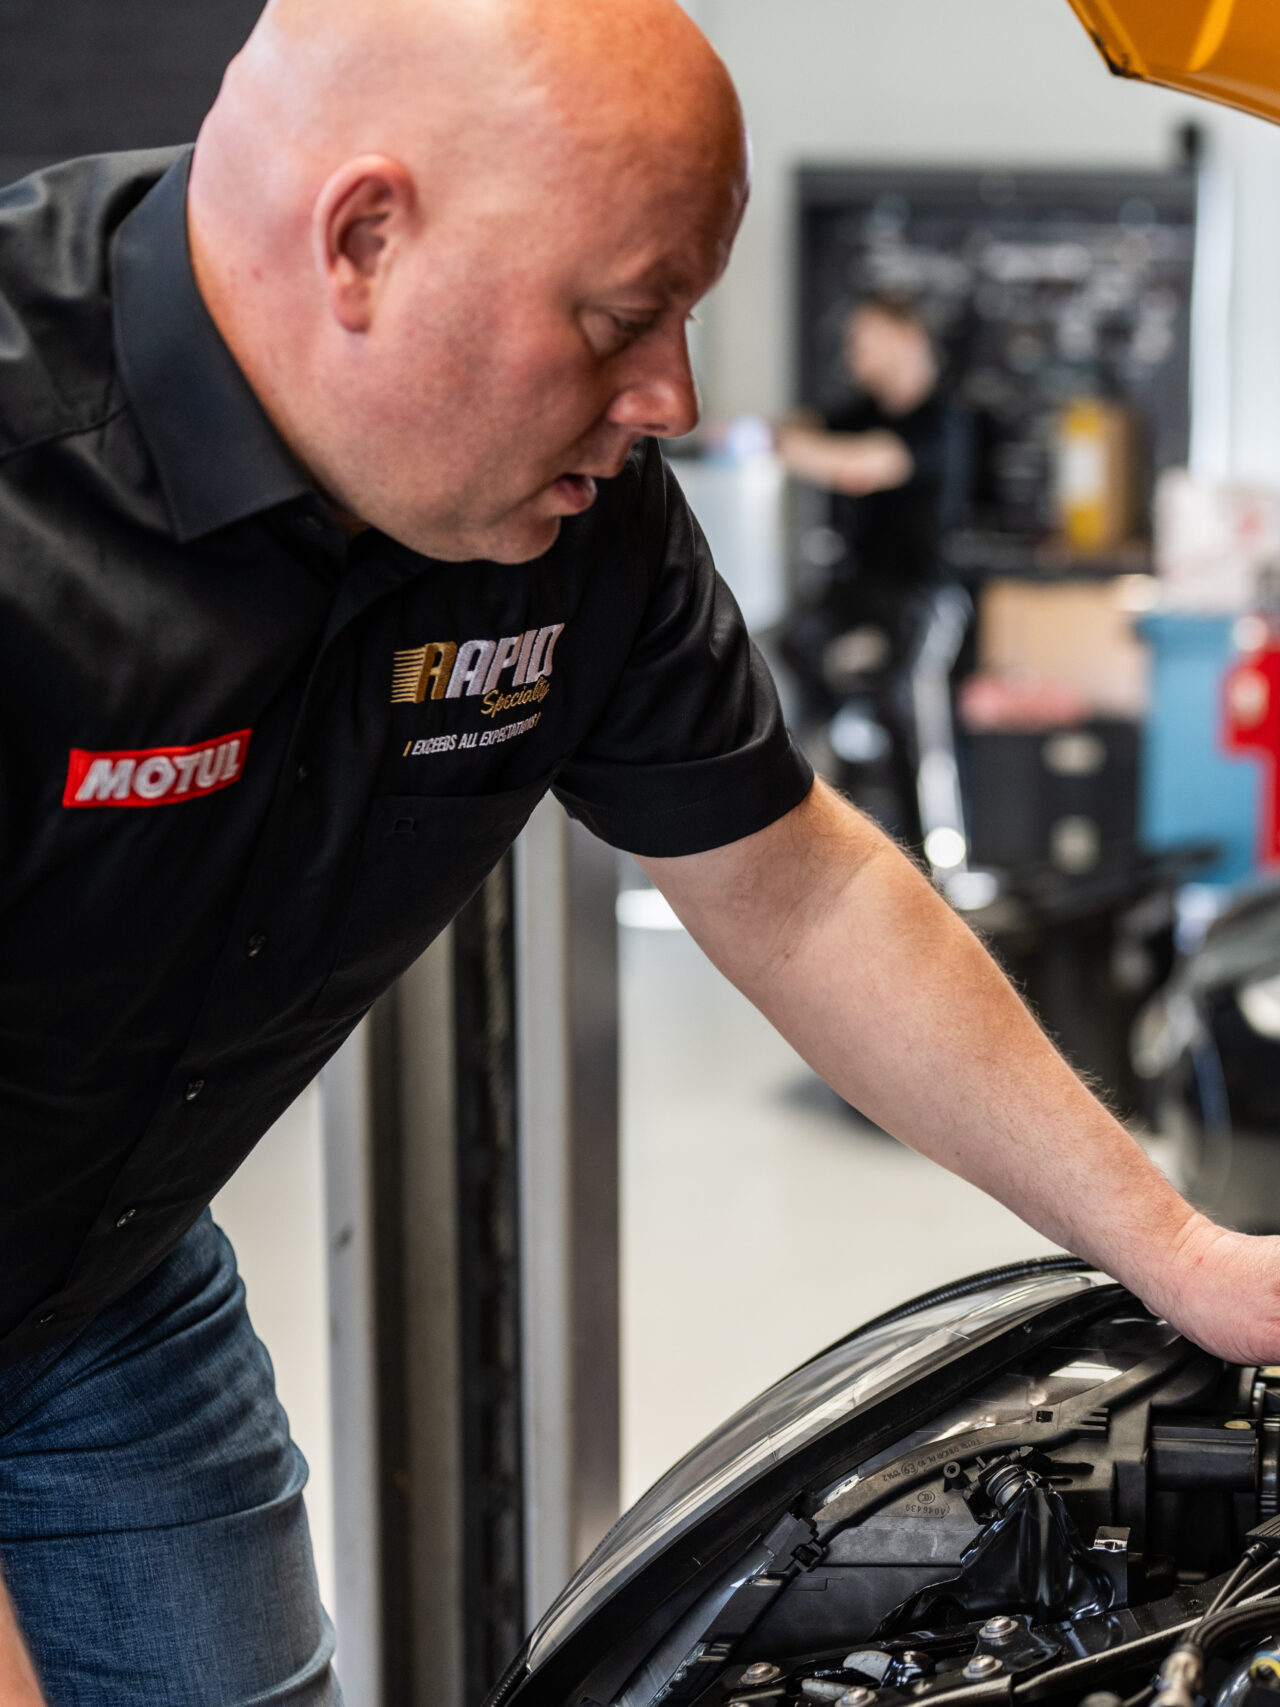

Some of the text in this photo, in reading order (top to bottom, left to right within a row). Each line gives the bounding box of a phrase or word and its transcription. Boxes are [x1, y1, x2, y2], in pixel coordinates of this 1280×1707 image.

[413, 622, 565, 705] RAPID
[480, 676, 550, 718] Specialty
[75, 739, 240, 801] MOTUL
[411, 734, 458, 756] EXCEEDS
[458, 732, 479, 750] ALL
